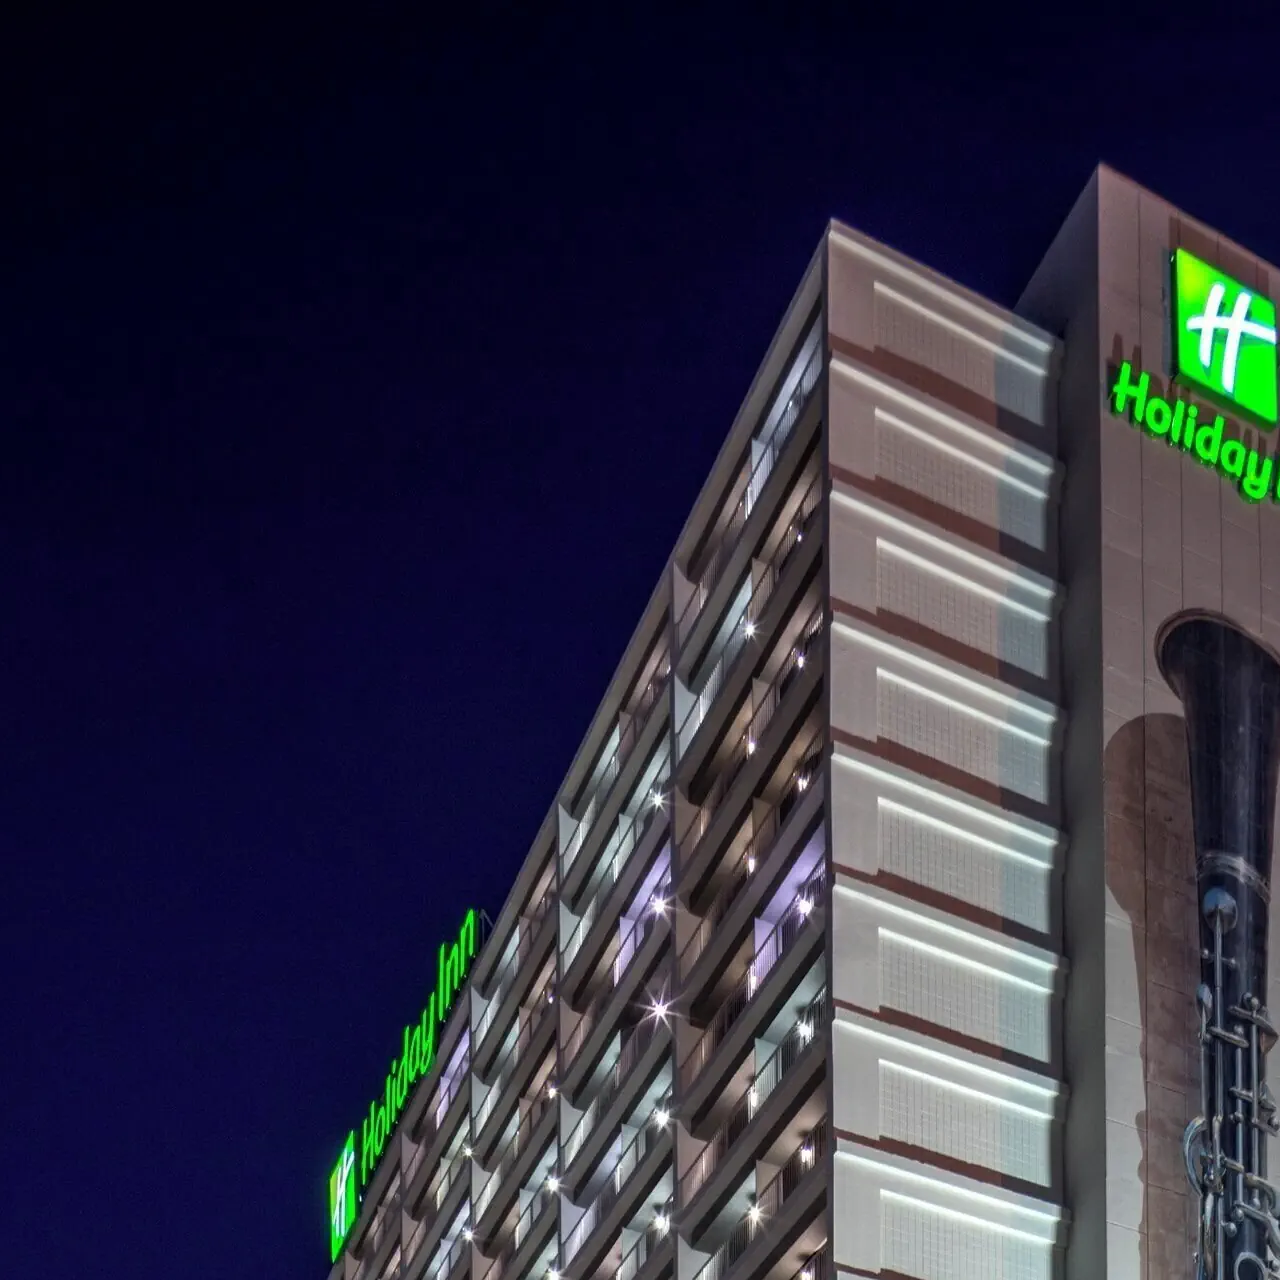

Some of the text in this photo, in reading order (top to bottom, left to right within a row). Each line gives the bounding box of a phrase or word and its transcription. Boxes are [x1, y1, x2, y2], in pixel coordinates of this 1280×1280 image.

[1111, 361, 1273, 500] Holiday
[361, 908, 474, 1186] Holiday Inn
